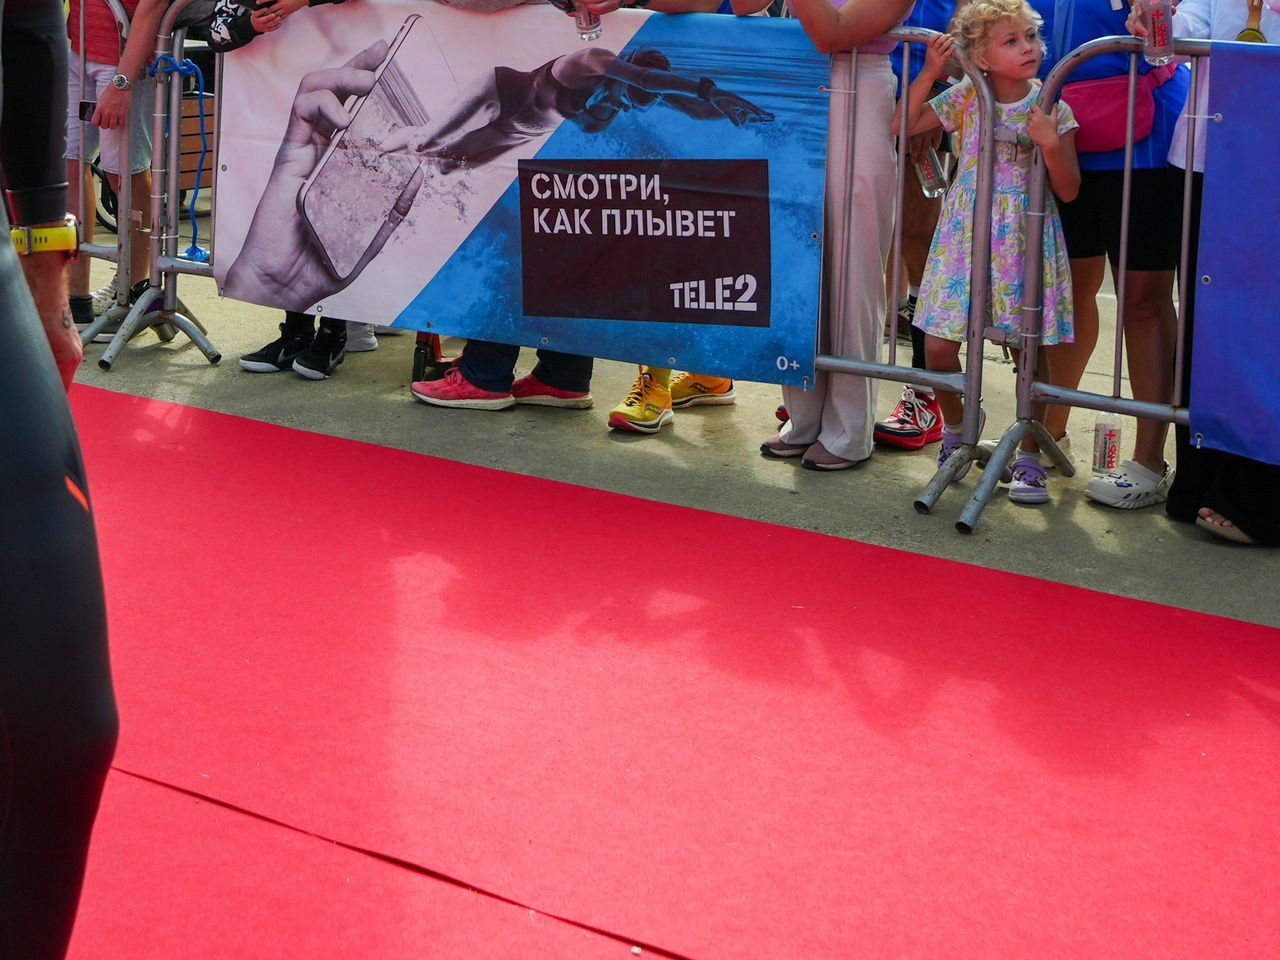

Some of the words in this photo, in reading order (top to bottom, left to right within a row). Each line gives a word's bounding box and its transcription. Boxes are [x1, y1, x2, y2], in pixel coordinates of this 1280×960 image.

[531, 173, 670, 205] СМОТРИ,
[533, 208, 592, 234] КАК
[601, 209, 736, 237] ПЛЫВЕТ
[669, 273, 757, 311] TELE2
